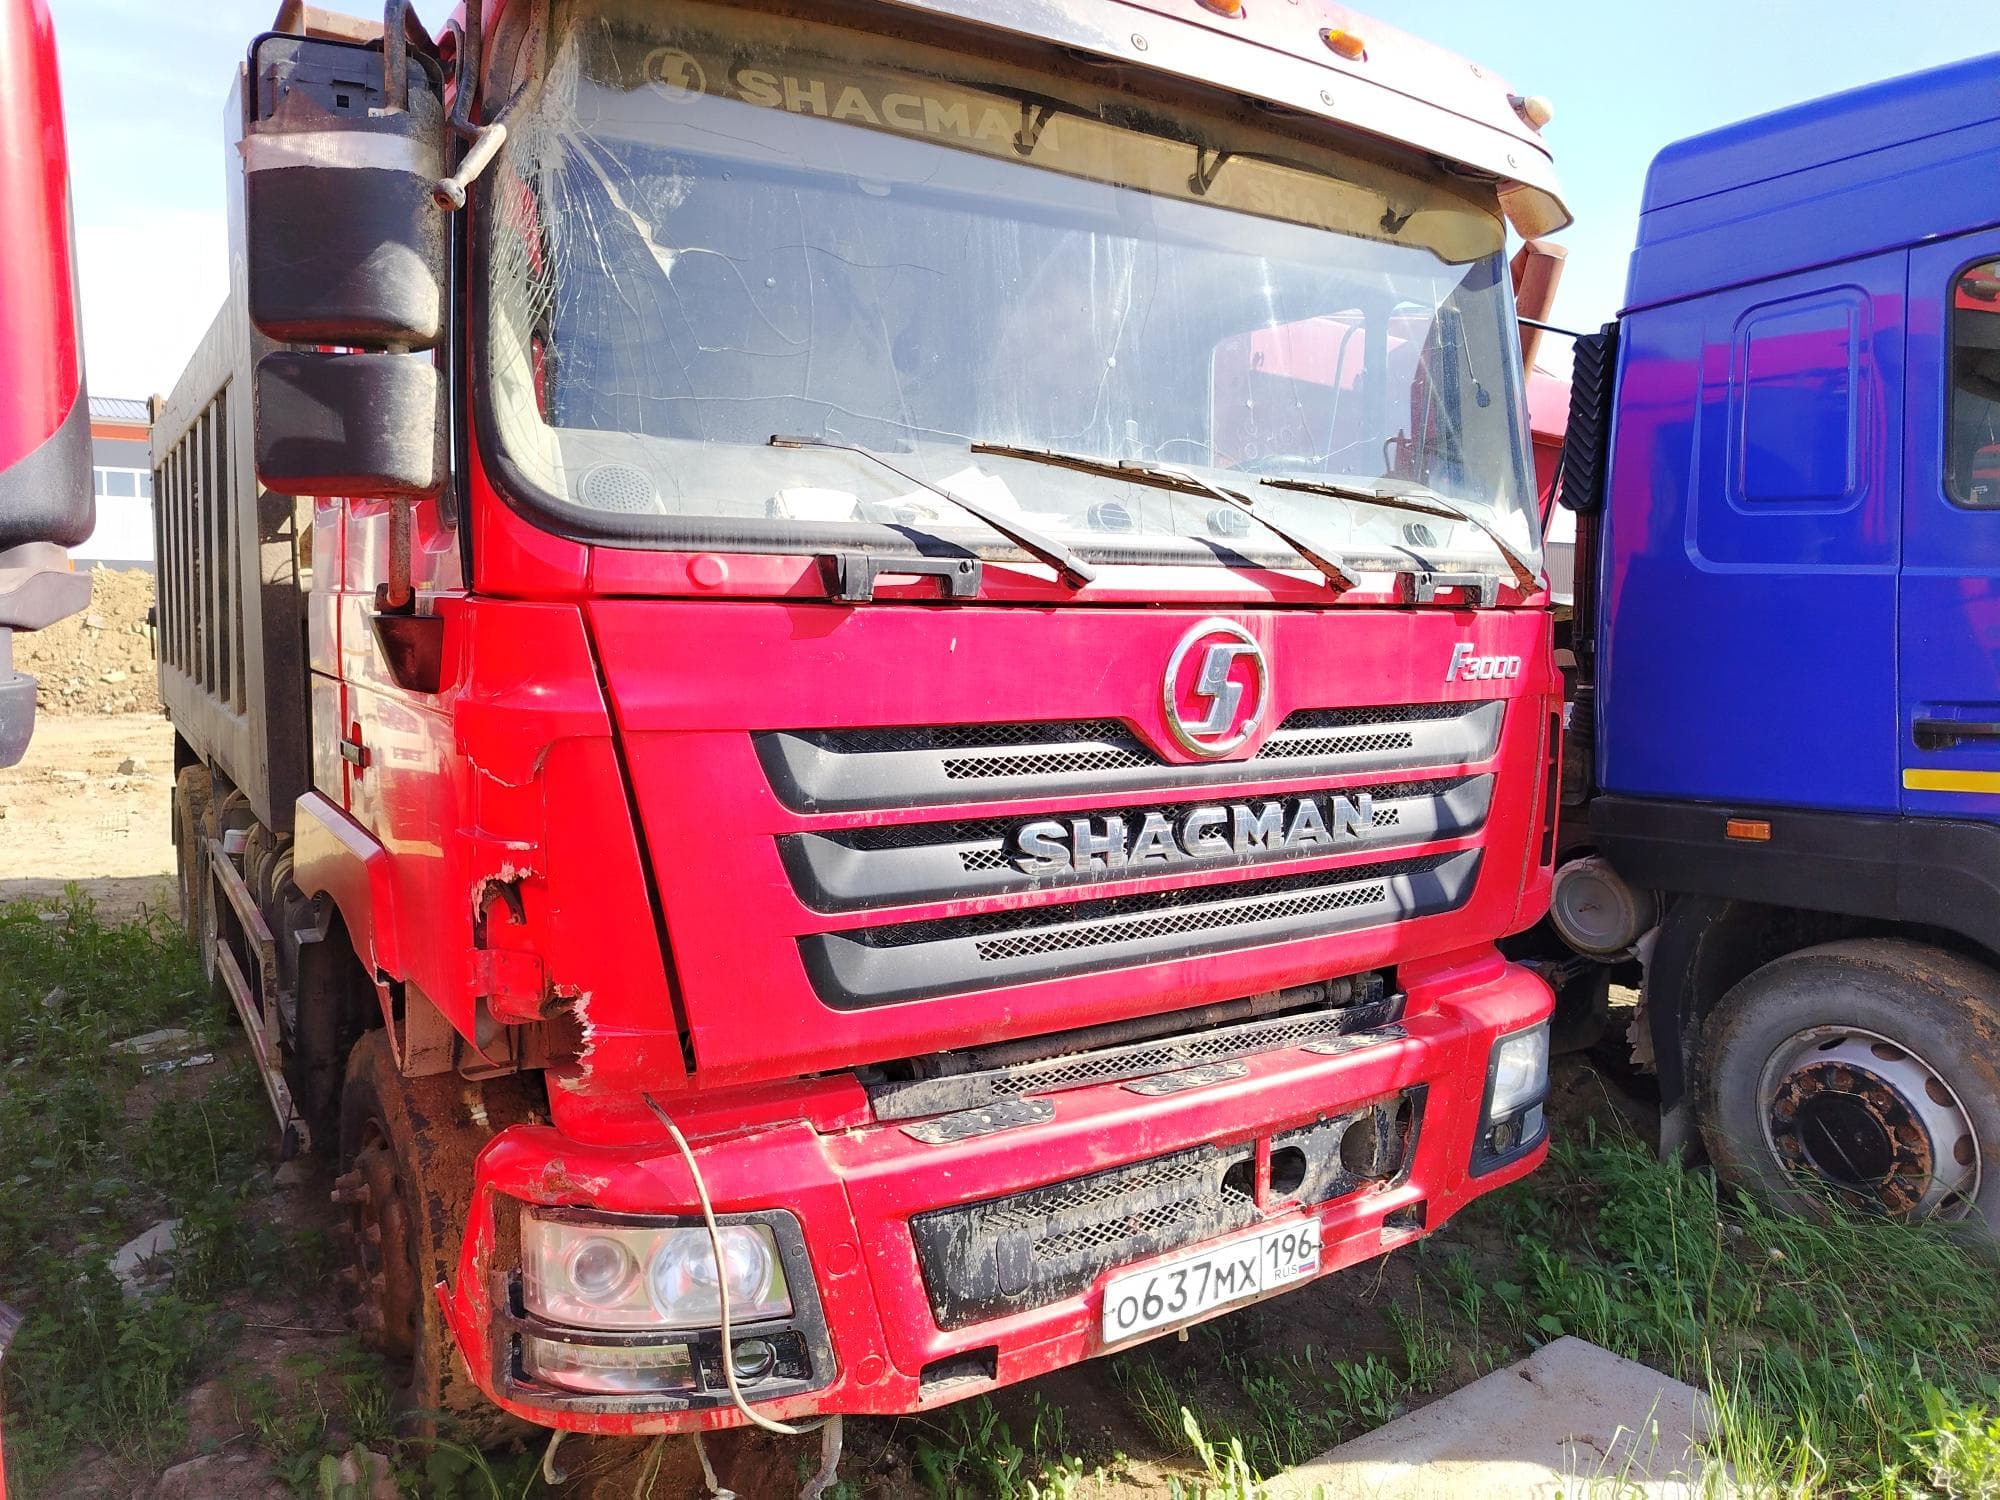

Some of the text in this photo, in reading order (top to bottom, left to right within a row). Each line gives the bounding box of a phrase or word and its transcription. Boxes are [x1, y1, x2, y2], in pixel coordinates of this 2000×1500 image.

[737, 69, 1059, 152] SHACMAN
[1445, 643, 1521, 682] F3000
[1015, 792, 1373, 876] SHACMAN
[1266, 1229, 1311, 1269] 196
[1274, 1265, 1297, 1280] RUS
